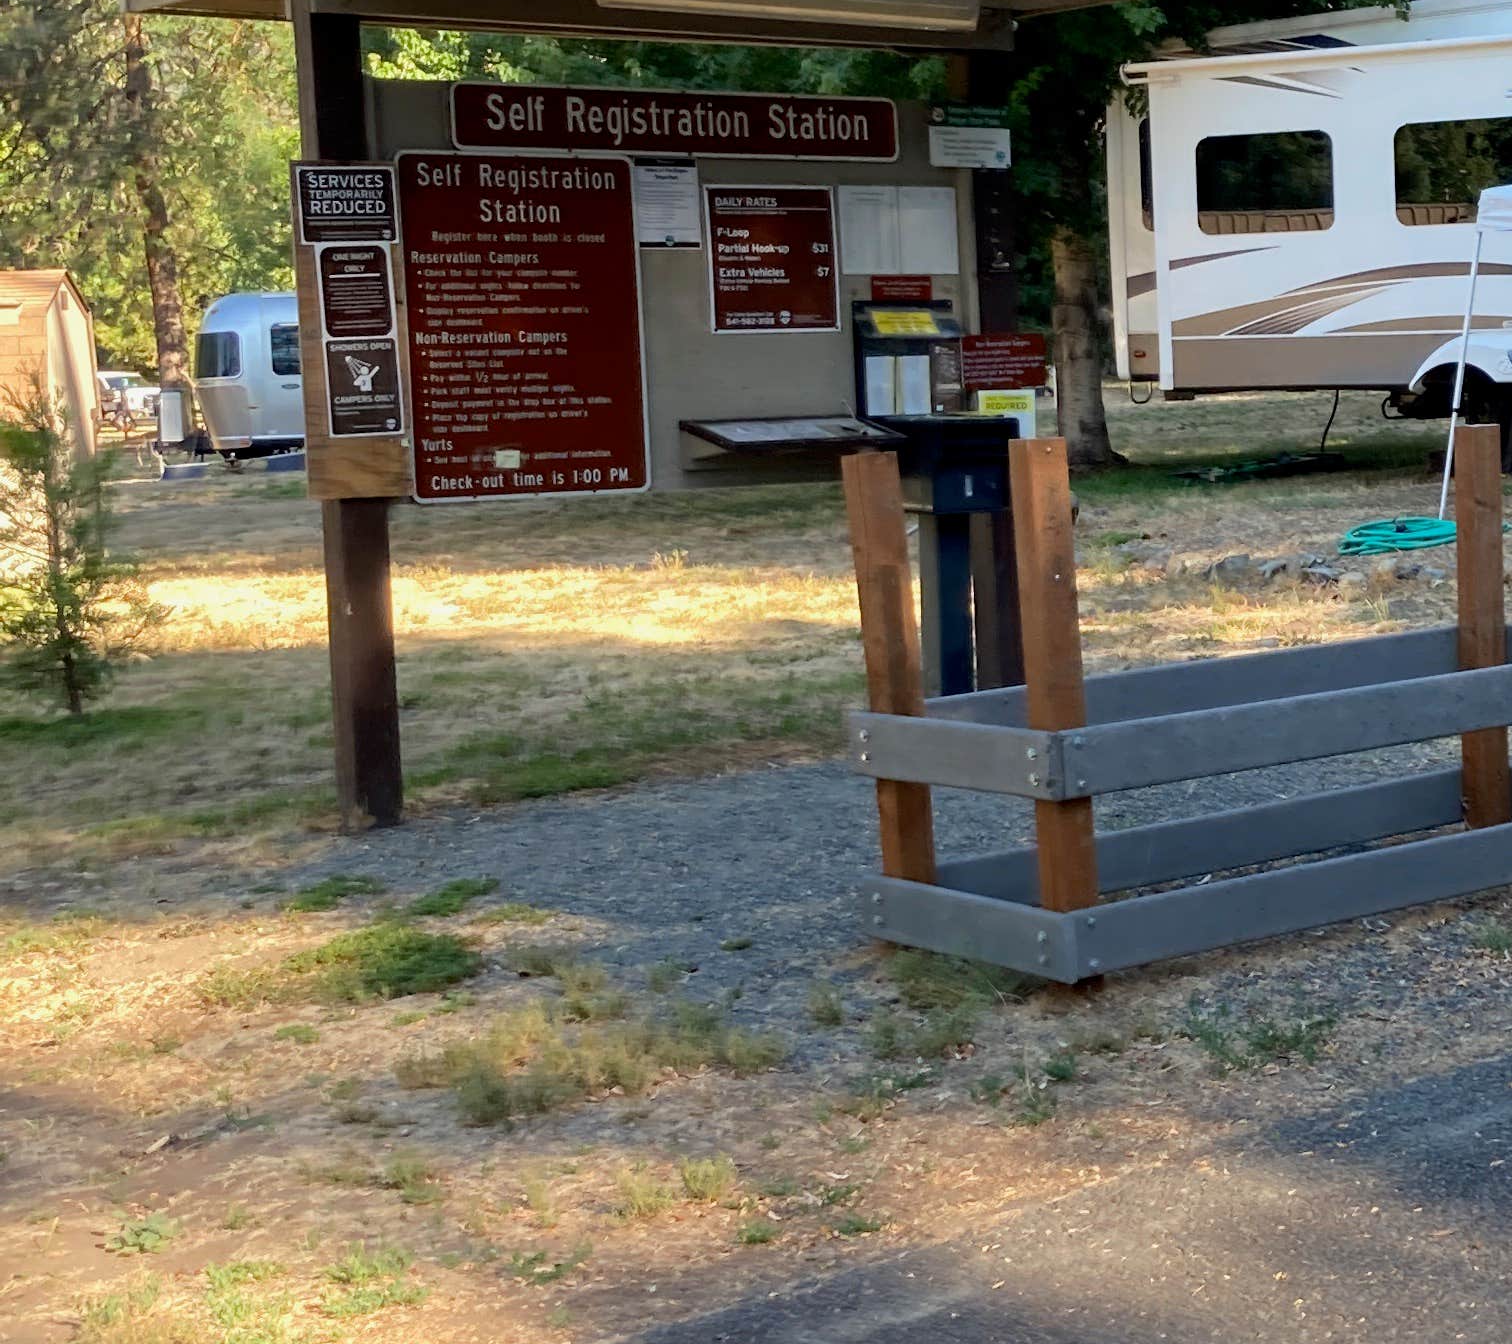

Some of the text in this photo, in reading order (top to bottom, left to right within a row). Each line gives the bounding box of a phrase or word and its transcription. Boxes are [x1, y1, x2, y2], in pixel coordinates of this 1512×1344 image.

[487, 94, 869, 145] Self Registration Station
[308, 175, 384, 188] SERVICES
[416, 162, 615, 195] Self Registration
[308, 189, 384, 199] TEMPORARILY
[310, 200, 386, 214] REDUCED
[714, 197, 778, 207] DAILY RATES
[479, 199, 561, 223] Station
[718, 243, 750, 254] Partial
[751, 243, 790, 255] Hook-up
[411, 251, 540, 266] Reservation Campers
[719, 267, 746, 277] Extra
[748, 267, 785, 277] Vehicles
[415, 330, 568, 346] Non-Reservation Campers
[421, 439, 453, 452] Yurts
[431, 472, 504, 491] Check-out
[513, 472, 544, 488] time
[552, 470, 565, 485] is
[573, 468, 602, 484] 1:00
